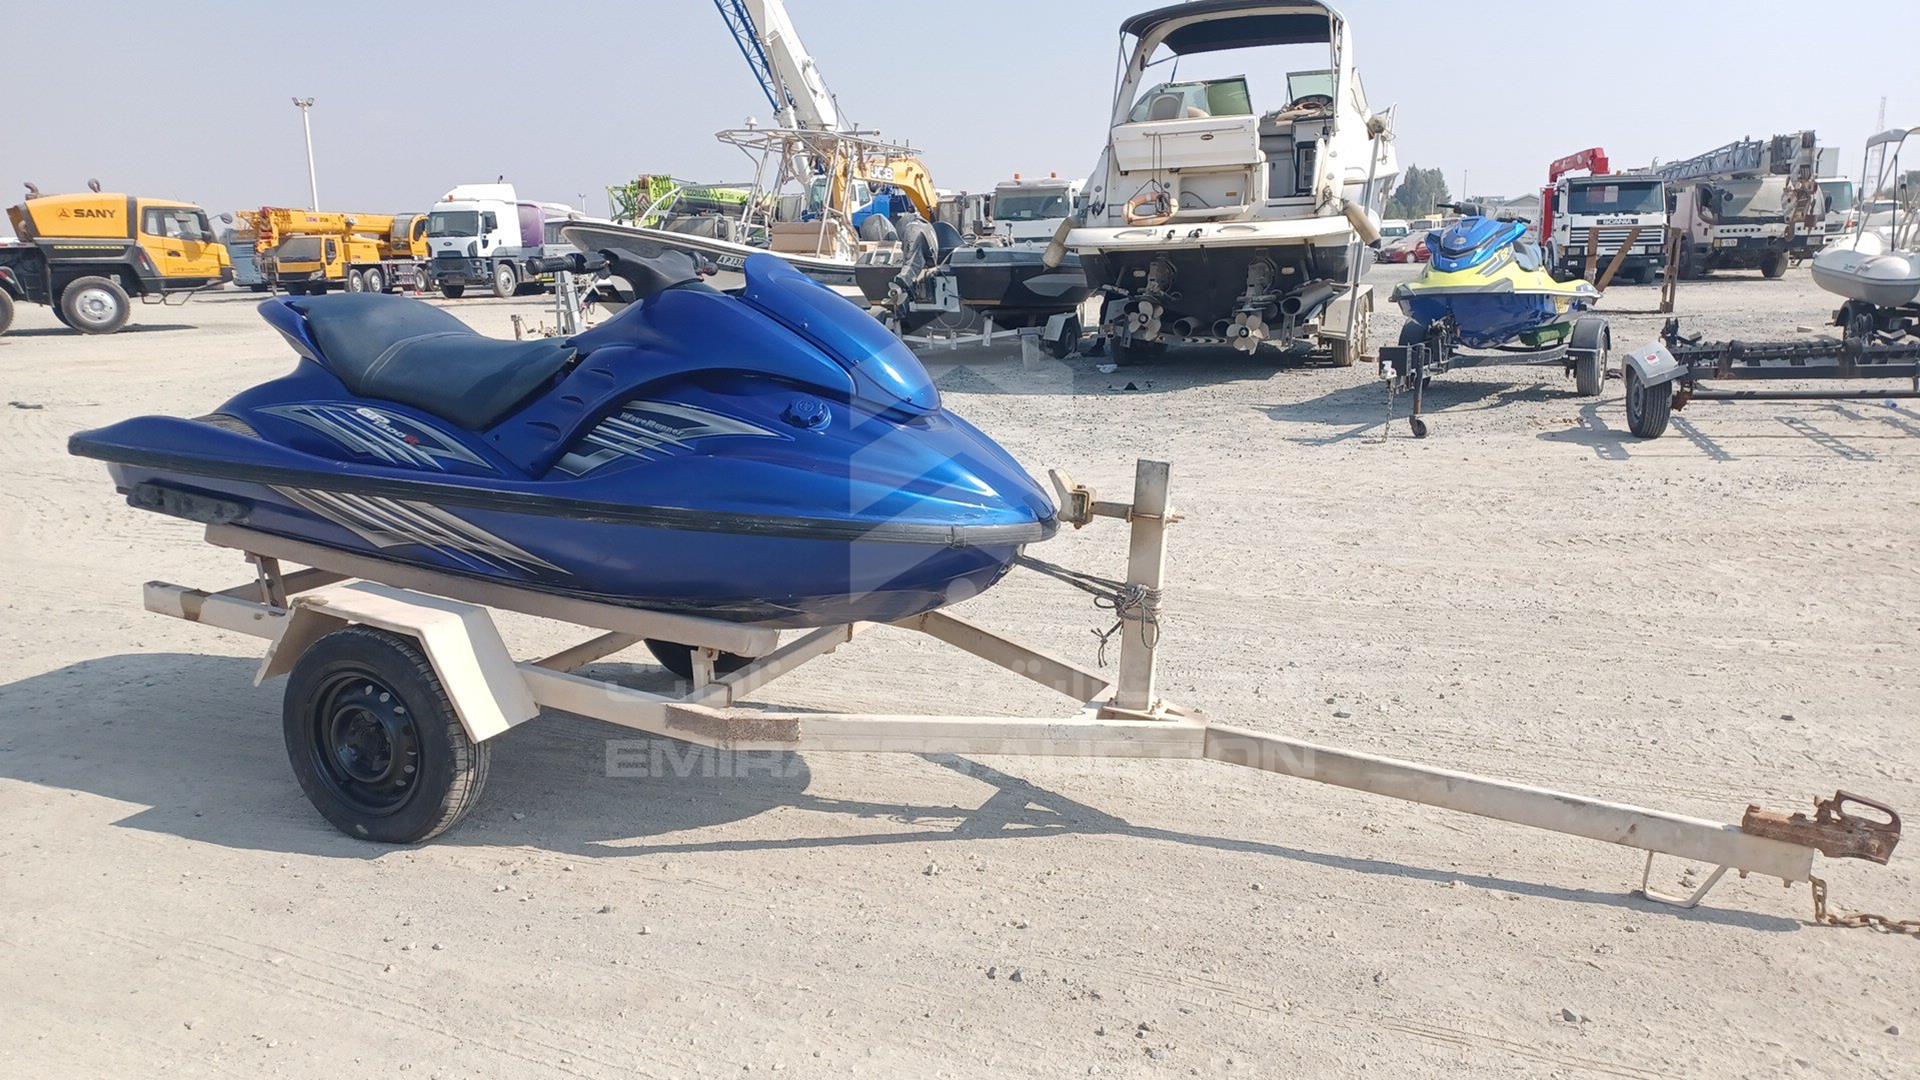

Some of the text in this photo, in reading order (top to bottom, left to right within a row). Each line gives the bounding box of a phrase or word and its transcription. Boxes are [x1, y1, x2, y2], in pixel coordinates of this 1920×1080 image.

[871, 165, 894, 181] JCB
[73, 208, 116, 219] SANY
[619, 411, 685, 437] WaveRunner
